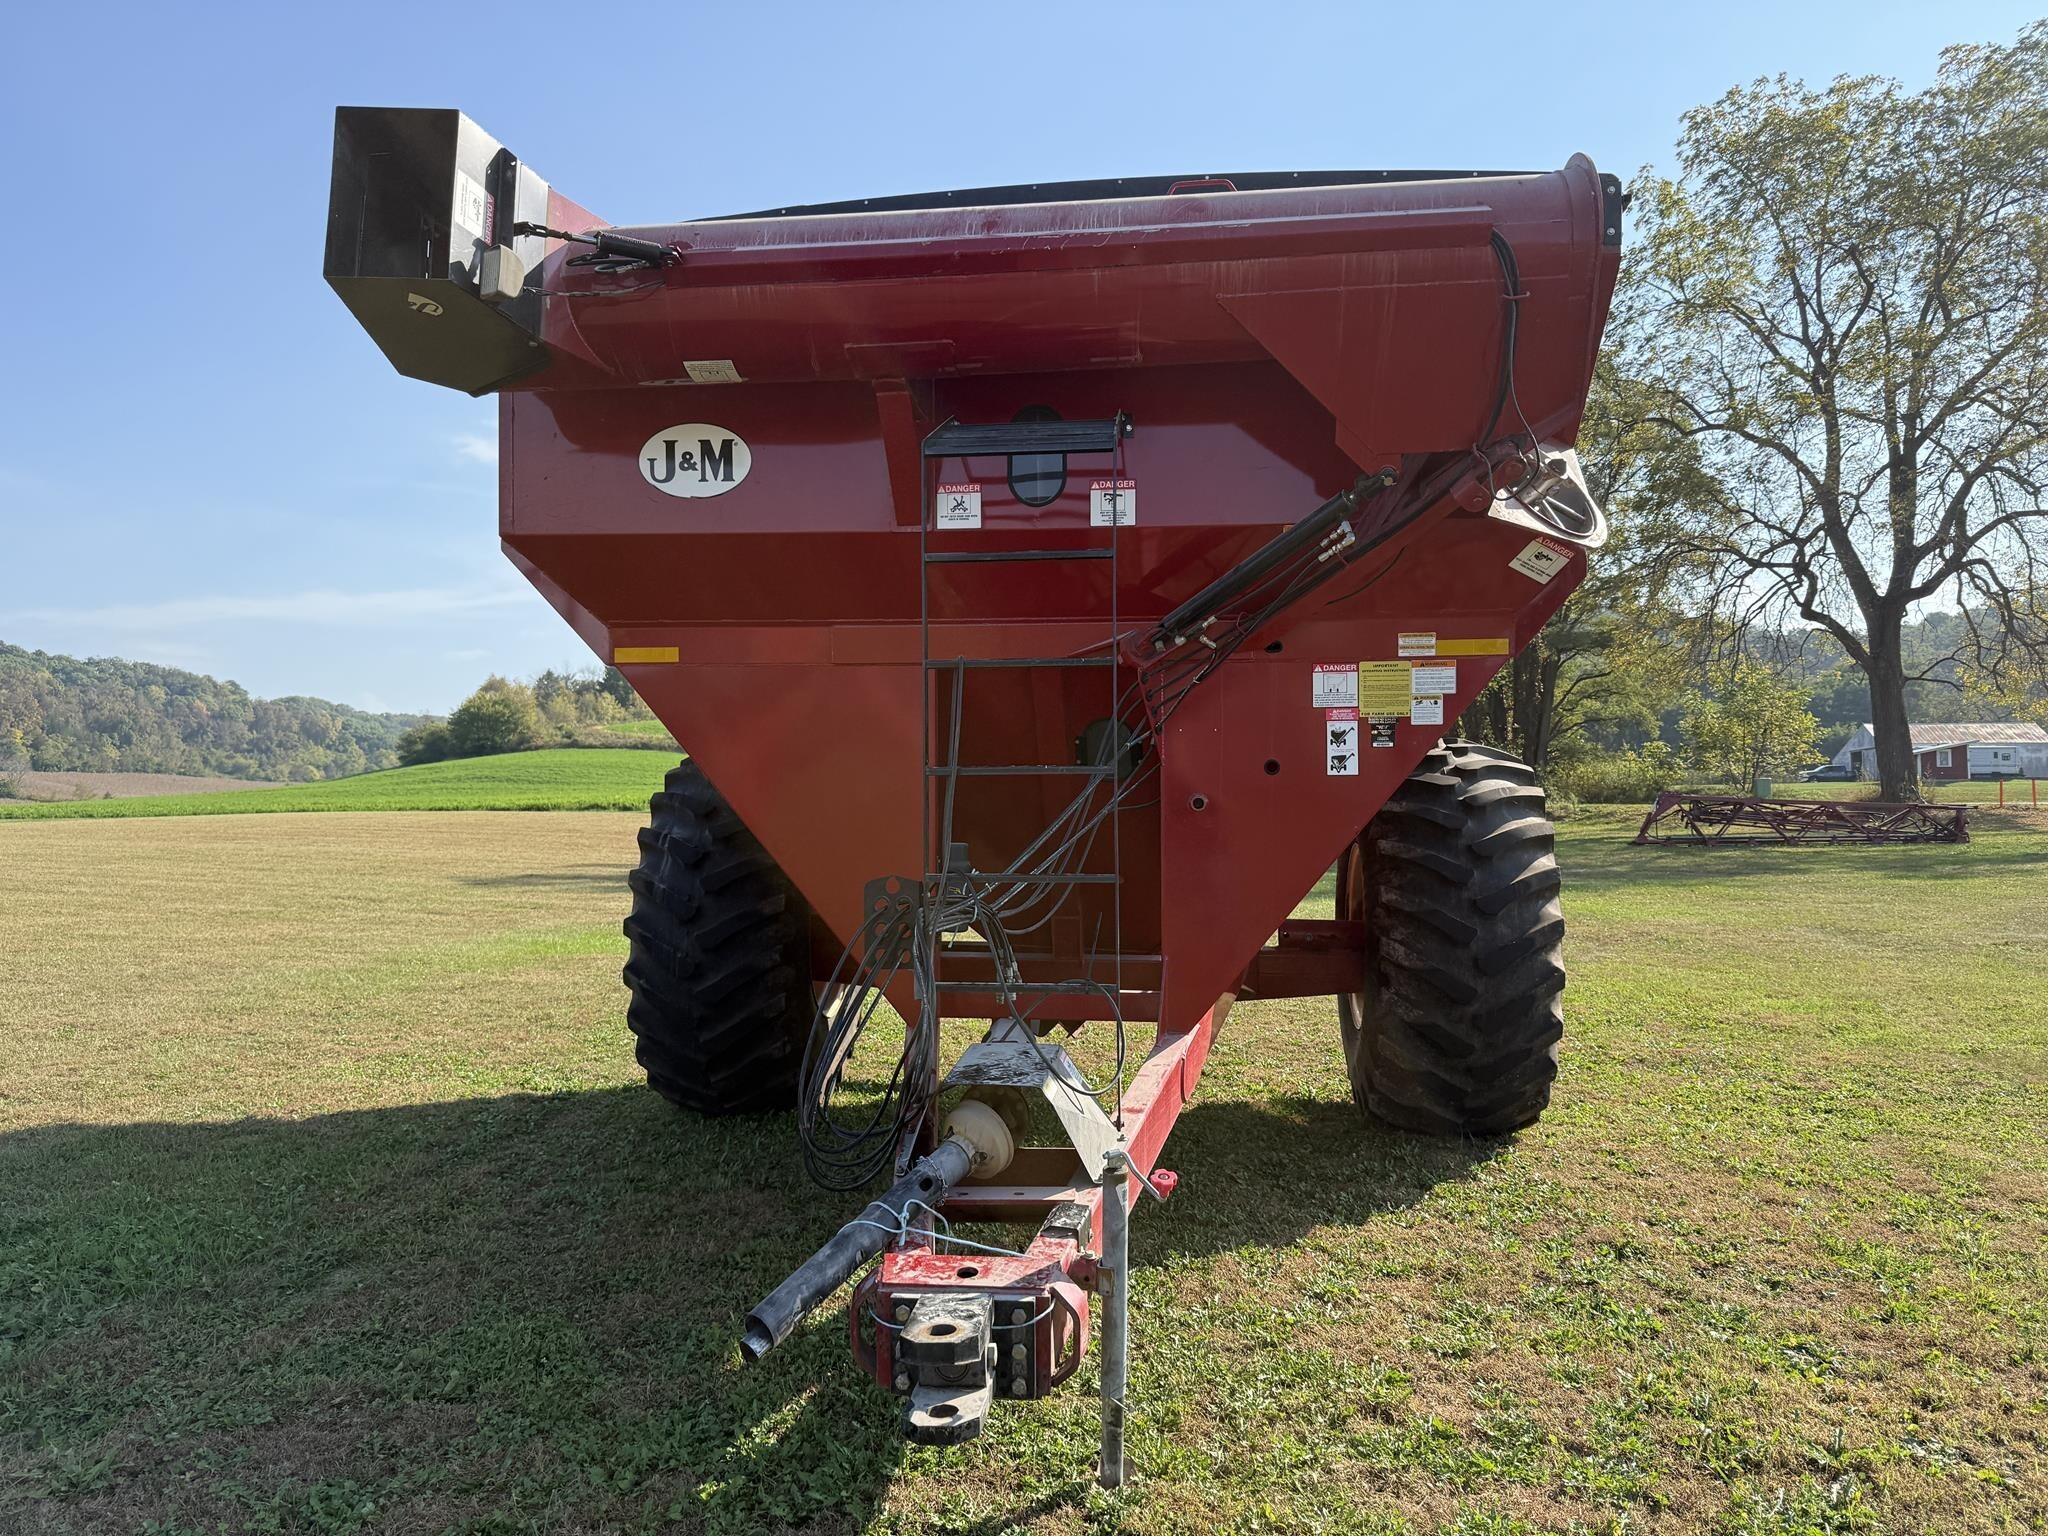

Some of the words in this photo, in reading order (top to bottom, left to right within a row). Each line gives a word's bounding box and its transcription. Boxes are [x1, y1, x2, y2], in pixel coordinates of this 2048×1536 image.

[484, 203, 495, 246] DANGER
[647, 440, 735, 485] J&M
[945, 484, 980, 493] DANGER
[1543, 539, 1575, 559] DANGER
[1323, 664, 1357, 672] DANGER
